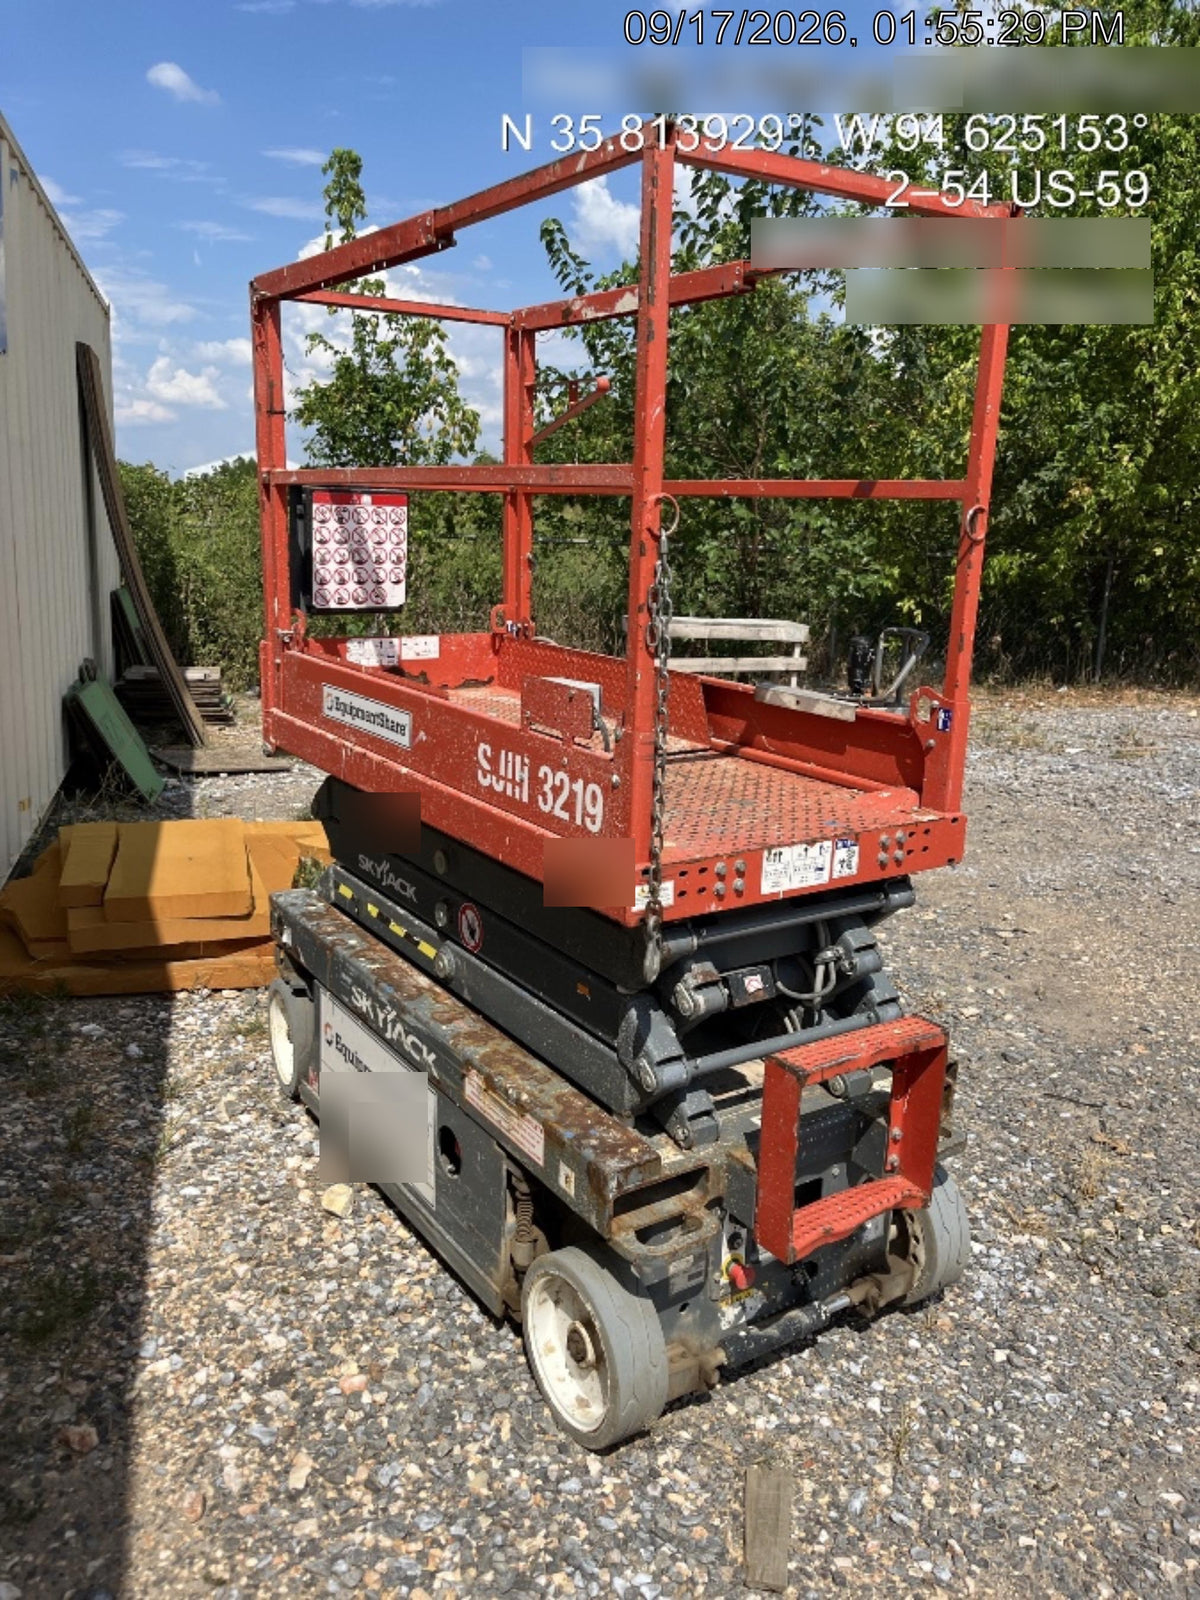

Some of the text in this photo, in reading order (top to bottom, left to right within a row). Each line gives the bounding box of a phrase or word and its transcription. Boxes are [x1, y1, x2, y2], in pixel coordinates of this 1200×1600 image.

[537, 764, 604, 833] 3219
[355, 851, 419, 904] SKYJACK
[351, 986, 440, 1080] SKYJACK
